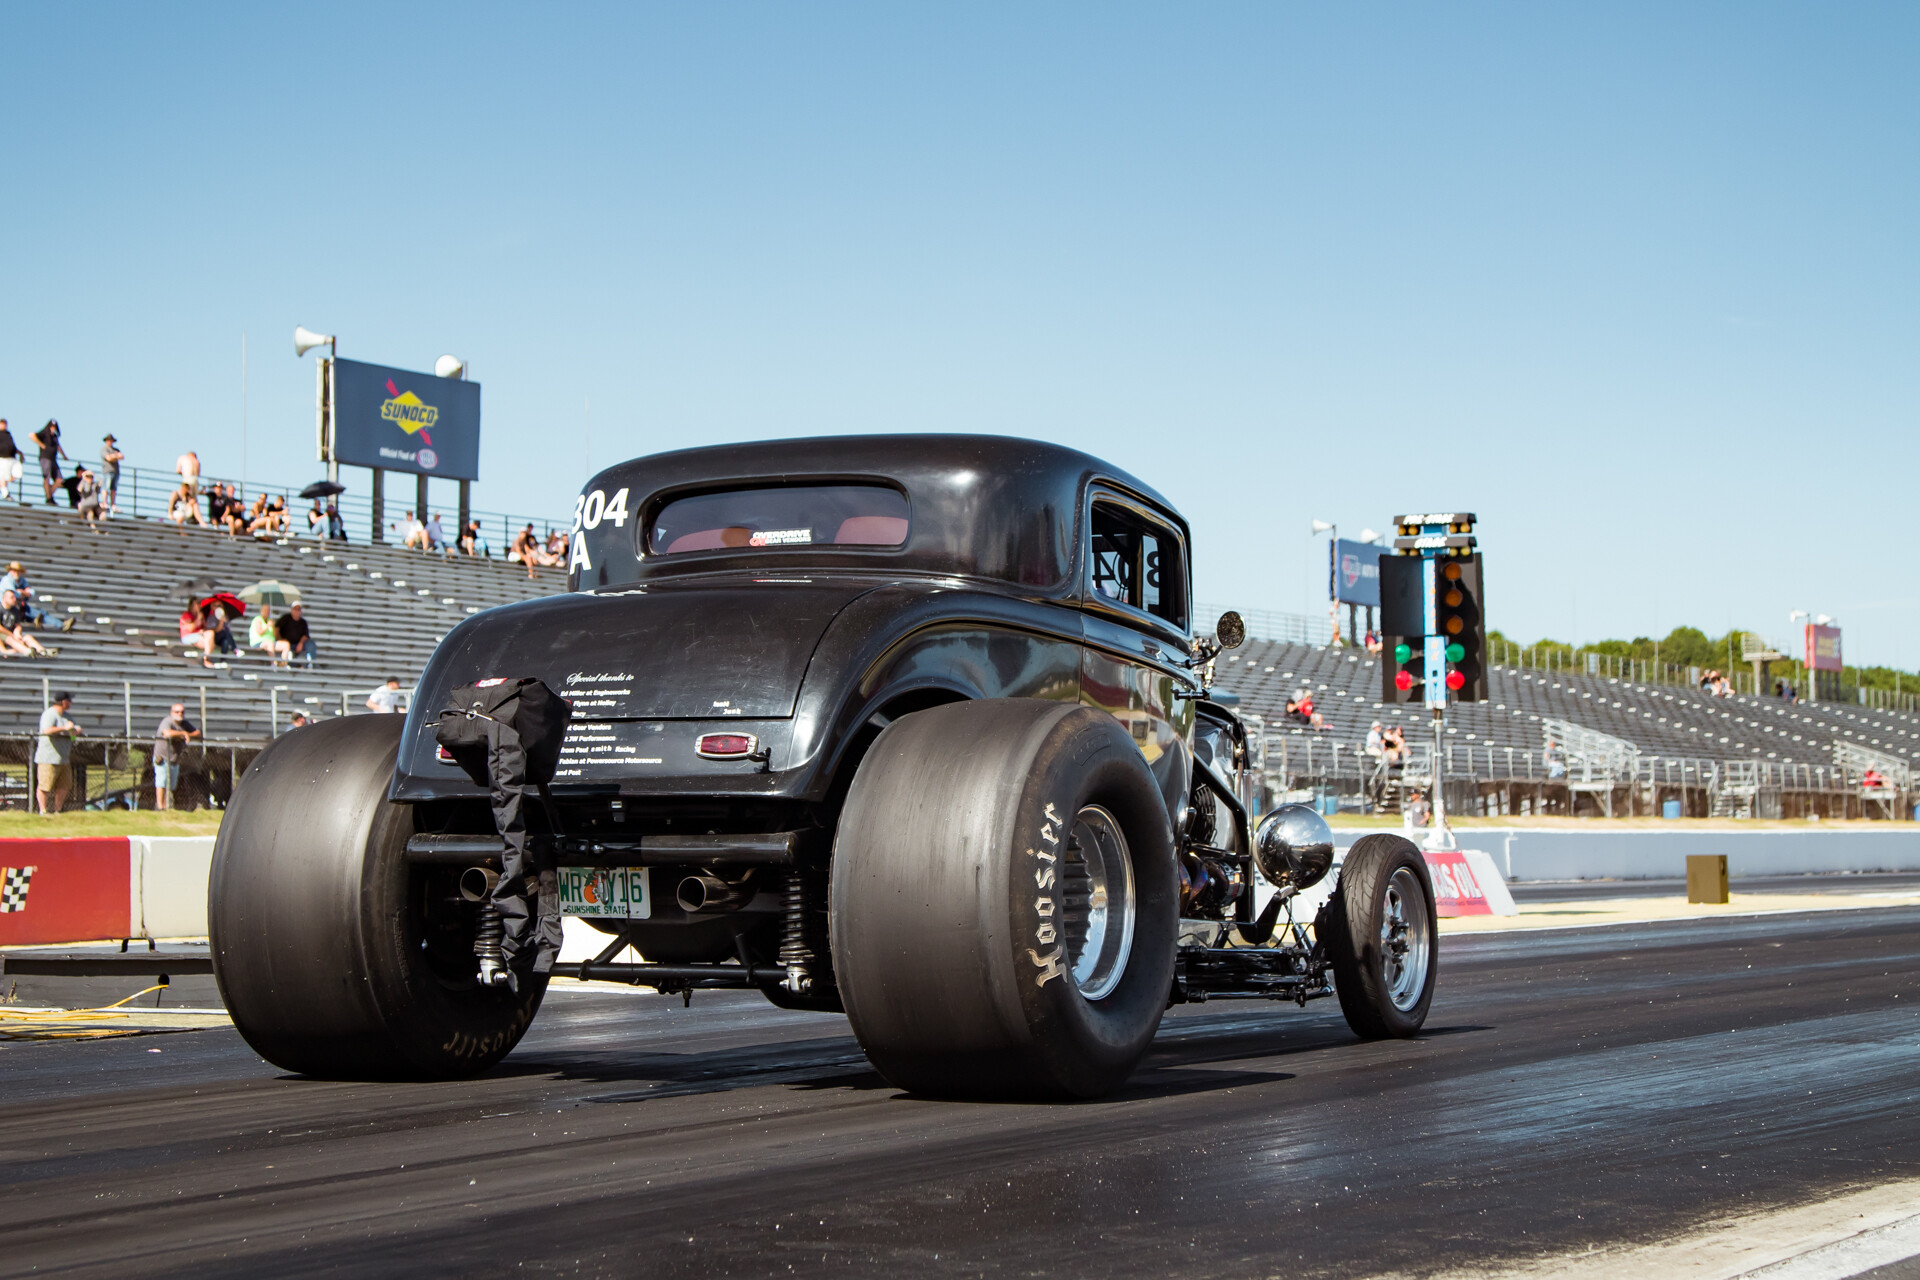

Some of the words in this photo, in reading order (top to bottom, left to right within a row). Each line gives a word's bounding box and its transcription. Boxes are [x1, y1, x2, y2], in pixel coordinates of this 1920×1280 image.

[384, 402, 436, 424] SUNOCO
[753, 529, 811, 538] OVERDRIVE
[569, 531, 592, 575] A
[566, 672, 601, 686] Special
[615, 746, 636, 754] Racing
[1025, 803, 1068, 988] Hoosier
[567, 905, 601, 914] SUNSHINE
[604, 905, 627, 915] STATE
